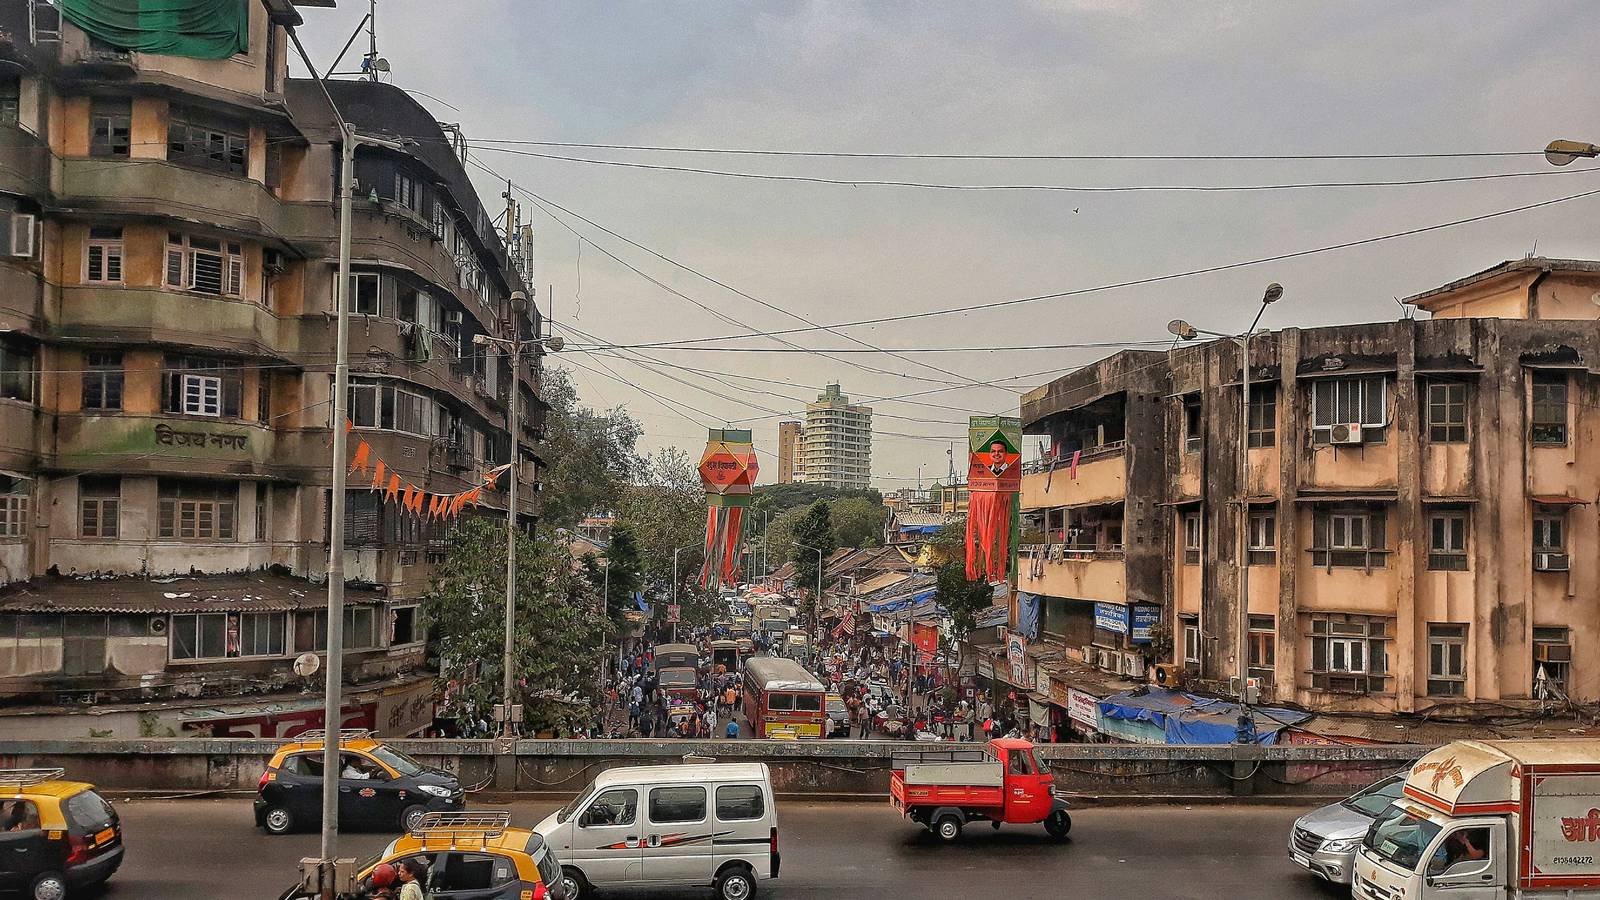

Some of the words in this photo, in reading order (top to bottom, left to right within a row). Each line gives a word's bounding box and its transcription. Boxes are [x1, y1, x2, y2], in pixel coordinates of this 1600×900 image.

[154, 423, 206, 448] विजय
[209, 432, 249, 451] नगर
[1115, 605, 1126, 613] CARD
